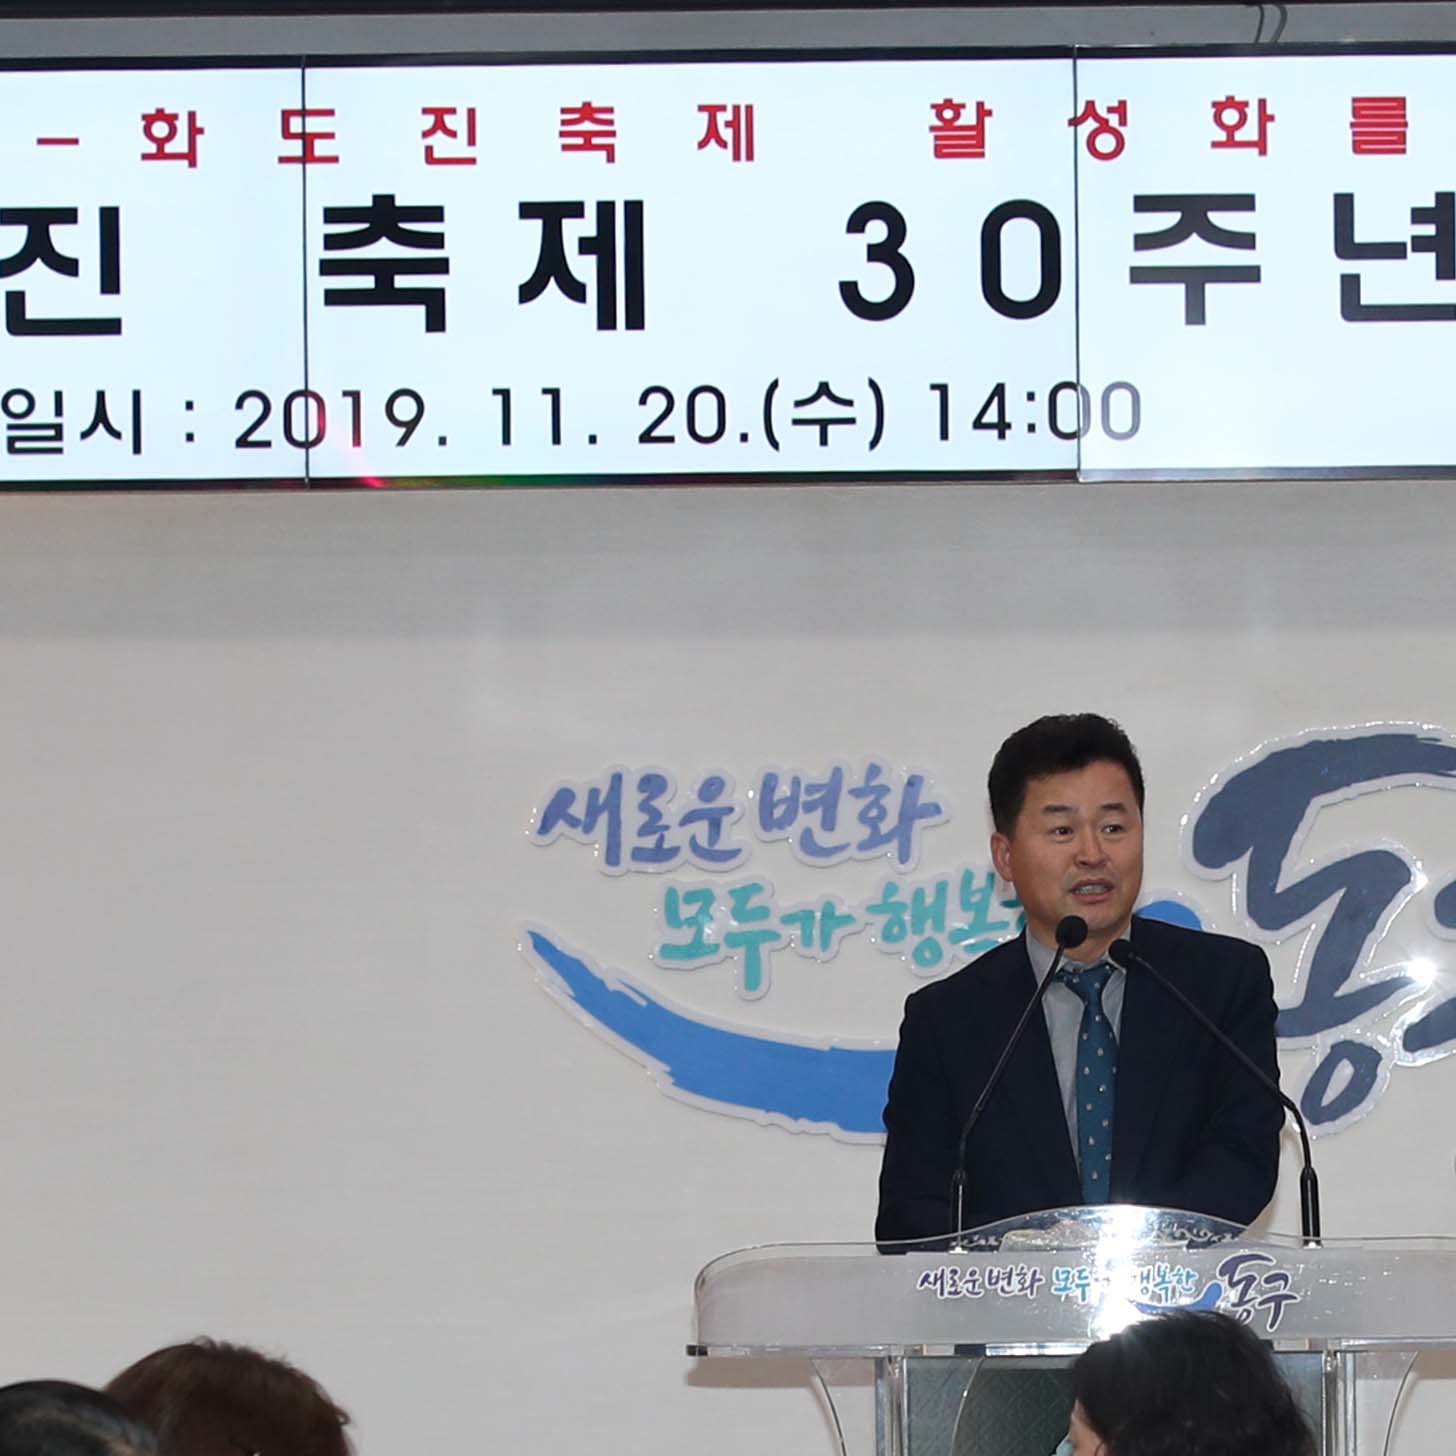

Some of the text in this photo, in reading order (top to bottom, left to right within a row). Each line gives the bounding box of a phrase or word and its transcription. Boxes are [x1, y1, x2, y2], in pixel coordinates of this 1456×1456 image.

[928, 95, 1409, 163] 활성화를
[318, 193, 646, 334] 축제
[0, 387, 142, 456] 일시
[234, 387, 448, 449] 2019.
[491, 387, 598, 446] 11.
[638, 377, 885, 452] 20.(수)
[929, 379, 1142, 443] 14:00
[537, 764, 942, 866] 새로운 변화
[659, 868, 1028, 992] 모두가 행복
[919, 1267, 981, 1297] 새로운
[986, 1266, 1043, 1297] 변화
[1054, 1268, 1111, 1301] 모두
[1217, 1252, 1300, 1331] 동구
